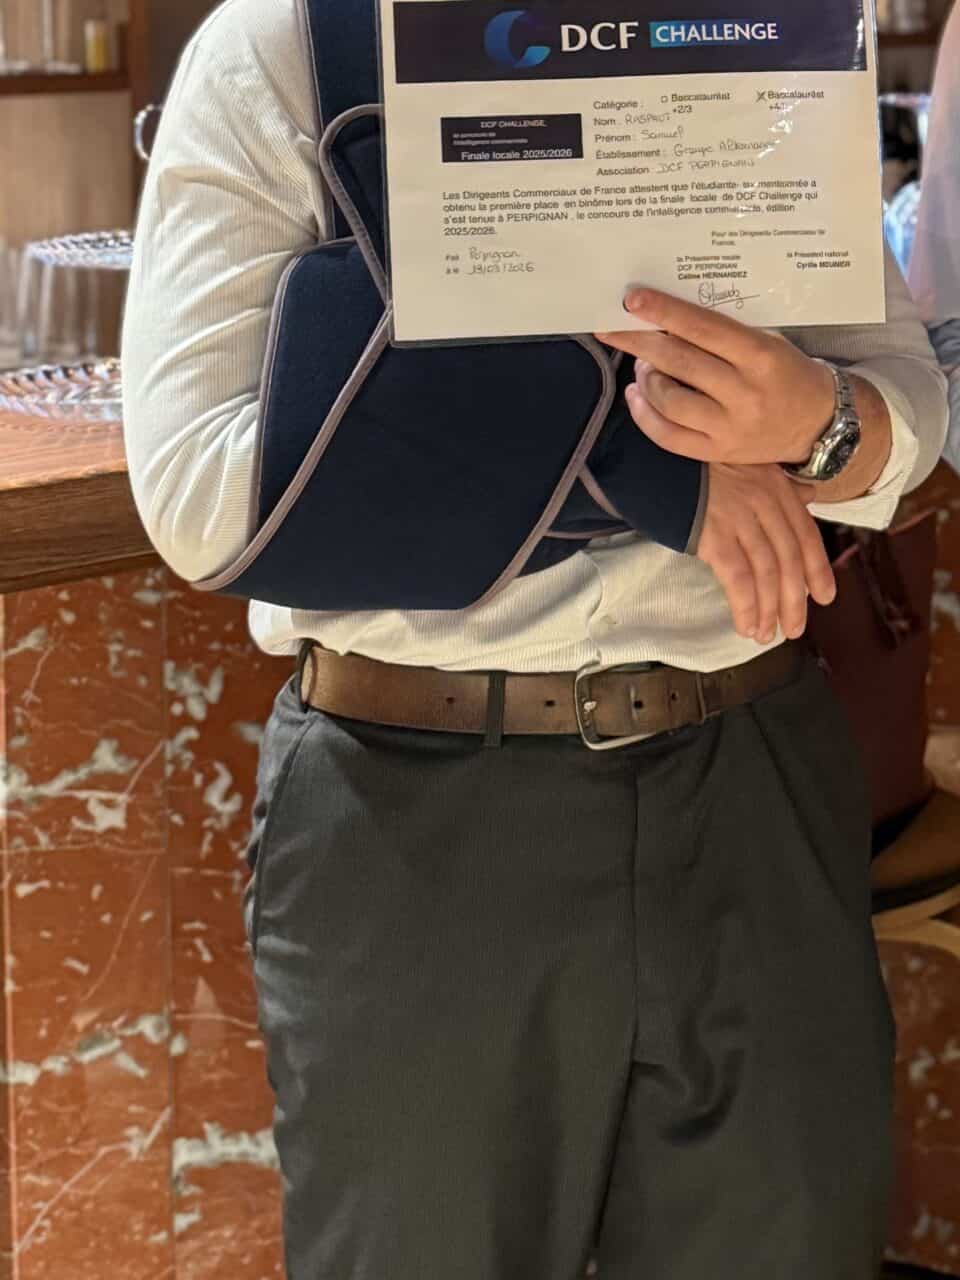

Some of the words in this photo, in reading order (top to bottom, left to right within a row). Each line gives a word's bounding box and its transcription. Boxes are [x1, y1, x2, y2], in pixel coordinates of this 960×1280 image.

[560, 22, 638, 51] DCF
[656, 22, 779, 41] CHALLENGE
[461, 151, 489, 160] Finale
[492, 150, 520, 159] locale
[463, 190, 509, 200] Dirigeants
[513, 188, 577, 198] Commerciaux
[580, 187, 592, 195] de
[594, 185, 626, 194] France
[534, 200, 560, 210] place
[736, 192, 757, 201] DCF
[758, 191, 803, 202] Challenge
[507, 212, 568, 222] PERPIGNAN
